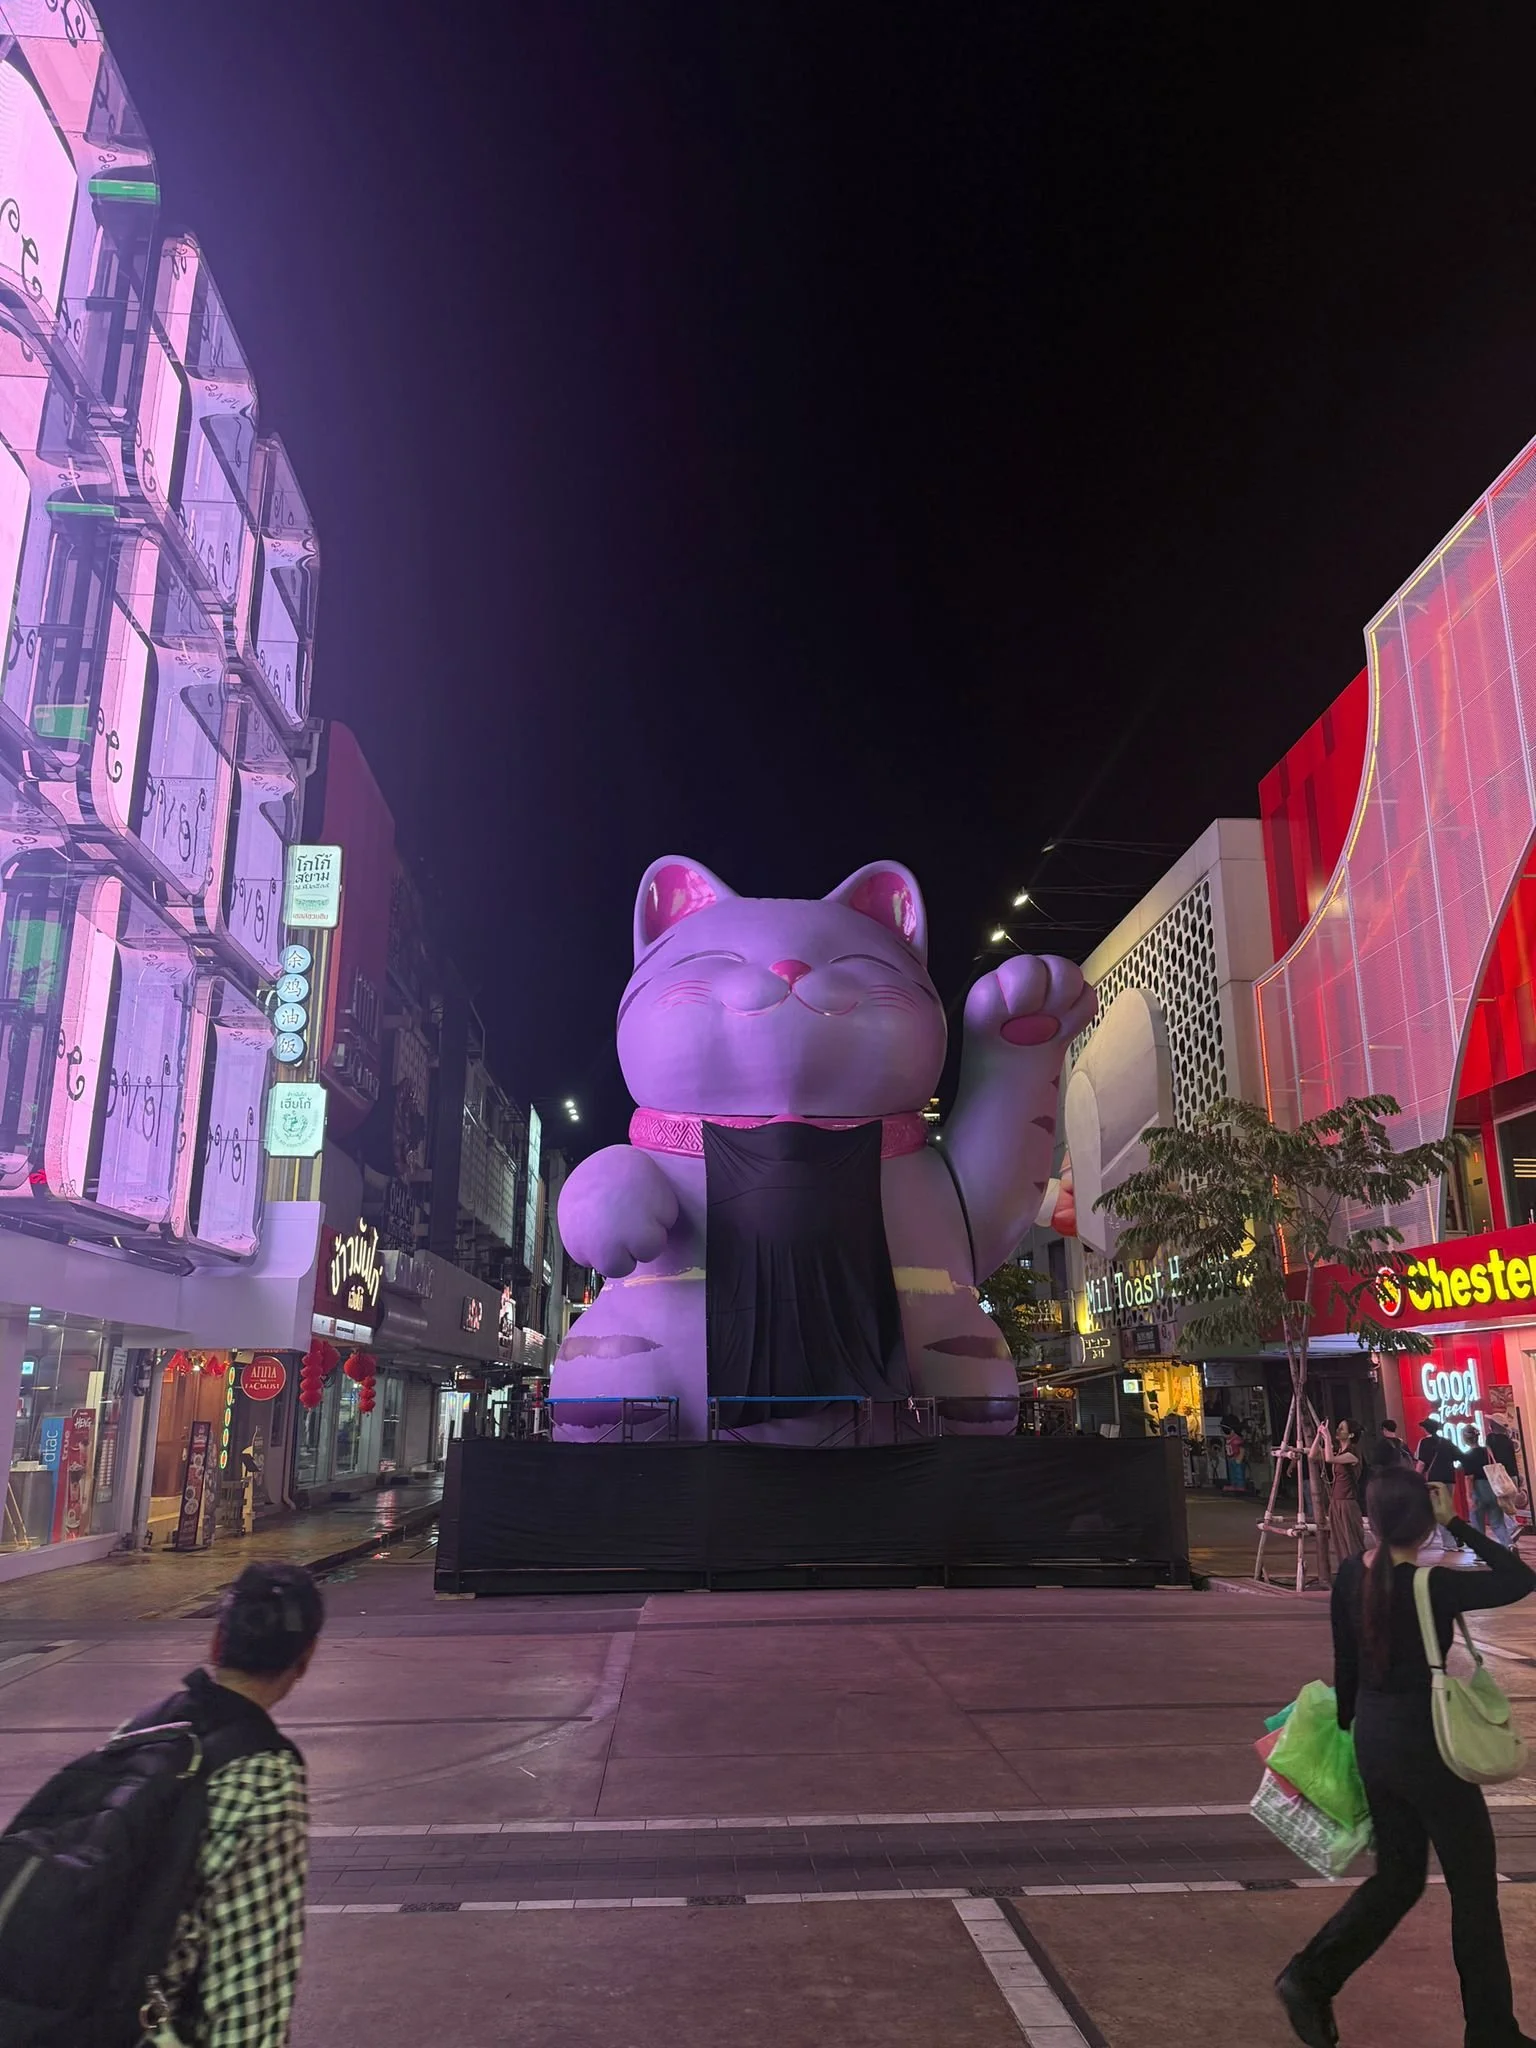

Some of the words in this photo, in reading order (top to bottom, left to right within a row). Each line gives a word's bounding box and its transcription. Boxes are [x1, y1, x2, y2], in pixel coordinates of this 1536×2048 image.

[330, 1216, 383, 1307] ข้าวมันไก่
[1086, 1277, 1113, 1315] Mil
[1115, 1265, 1165, 1309] Toast
[1421, 1357, 1481, 1402] Good
[1438, 1395, 1472, 1424] food
[43, 1430, 59, 1462] dtac
[61, 1430, 71, 1461] true
